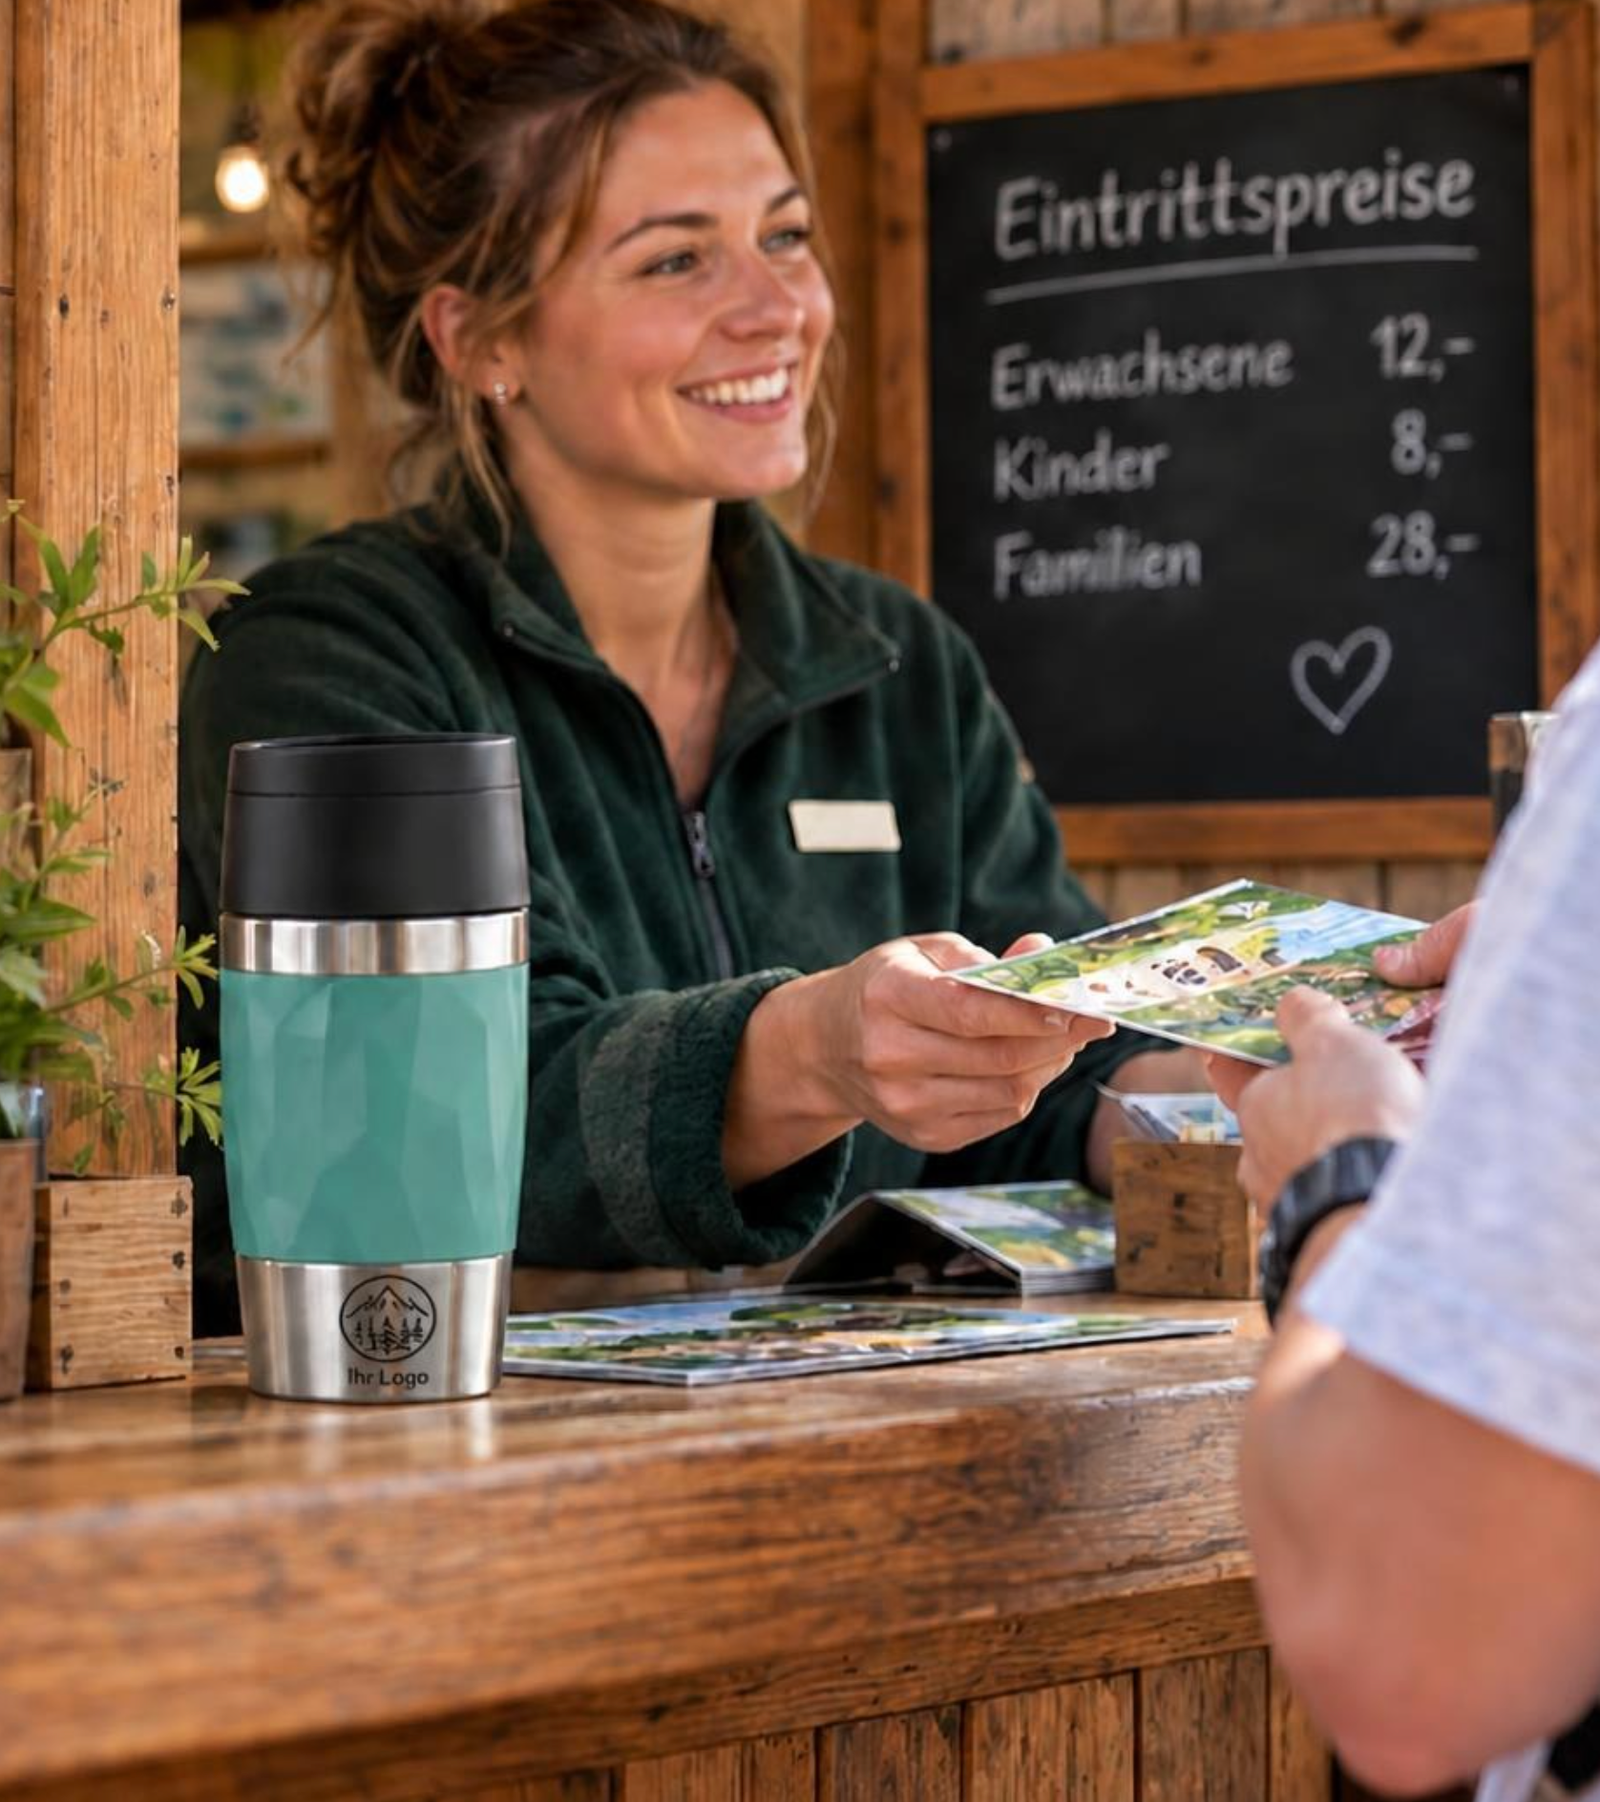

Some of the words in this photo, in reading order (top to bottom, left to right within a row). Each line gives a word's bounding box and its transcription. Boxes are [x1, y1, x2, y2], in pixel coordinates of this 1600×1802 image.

[993, 147, 1476, 261] Eintrittspreise
[990, 327, 1294, 410] Erwachsene
[992, 428, 1171, 501] Kinder
[993, 526, 1203, 600] Familien
[347, 1367, 375, 1386] Ihr
[378, 1367, 430, 1389] Logo
